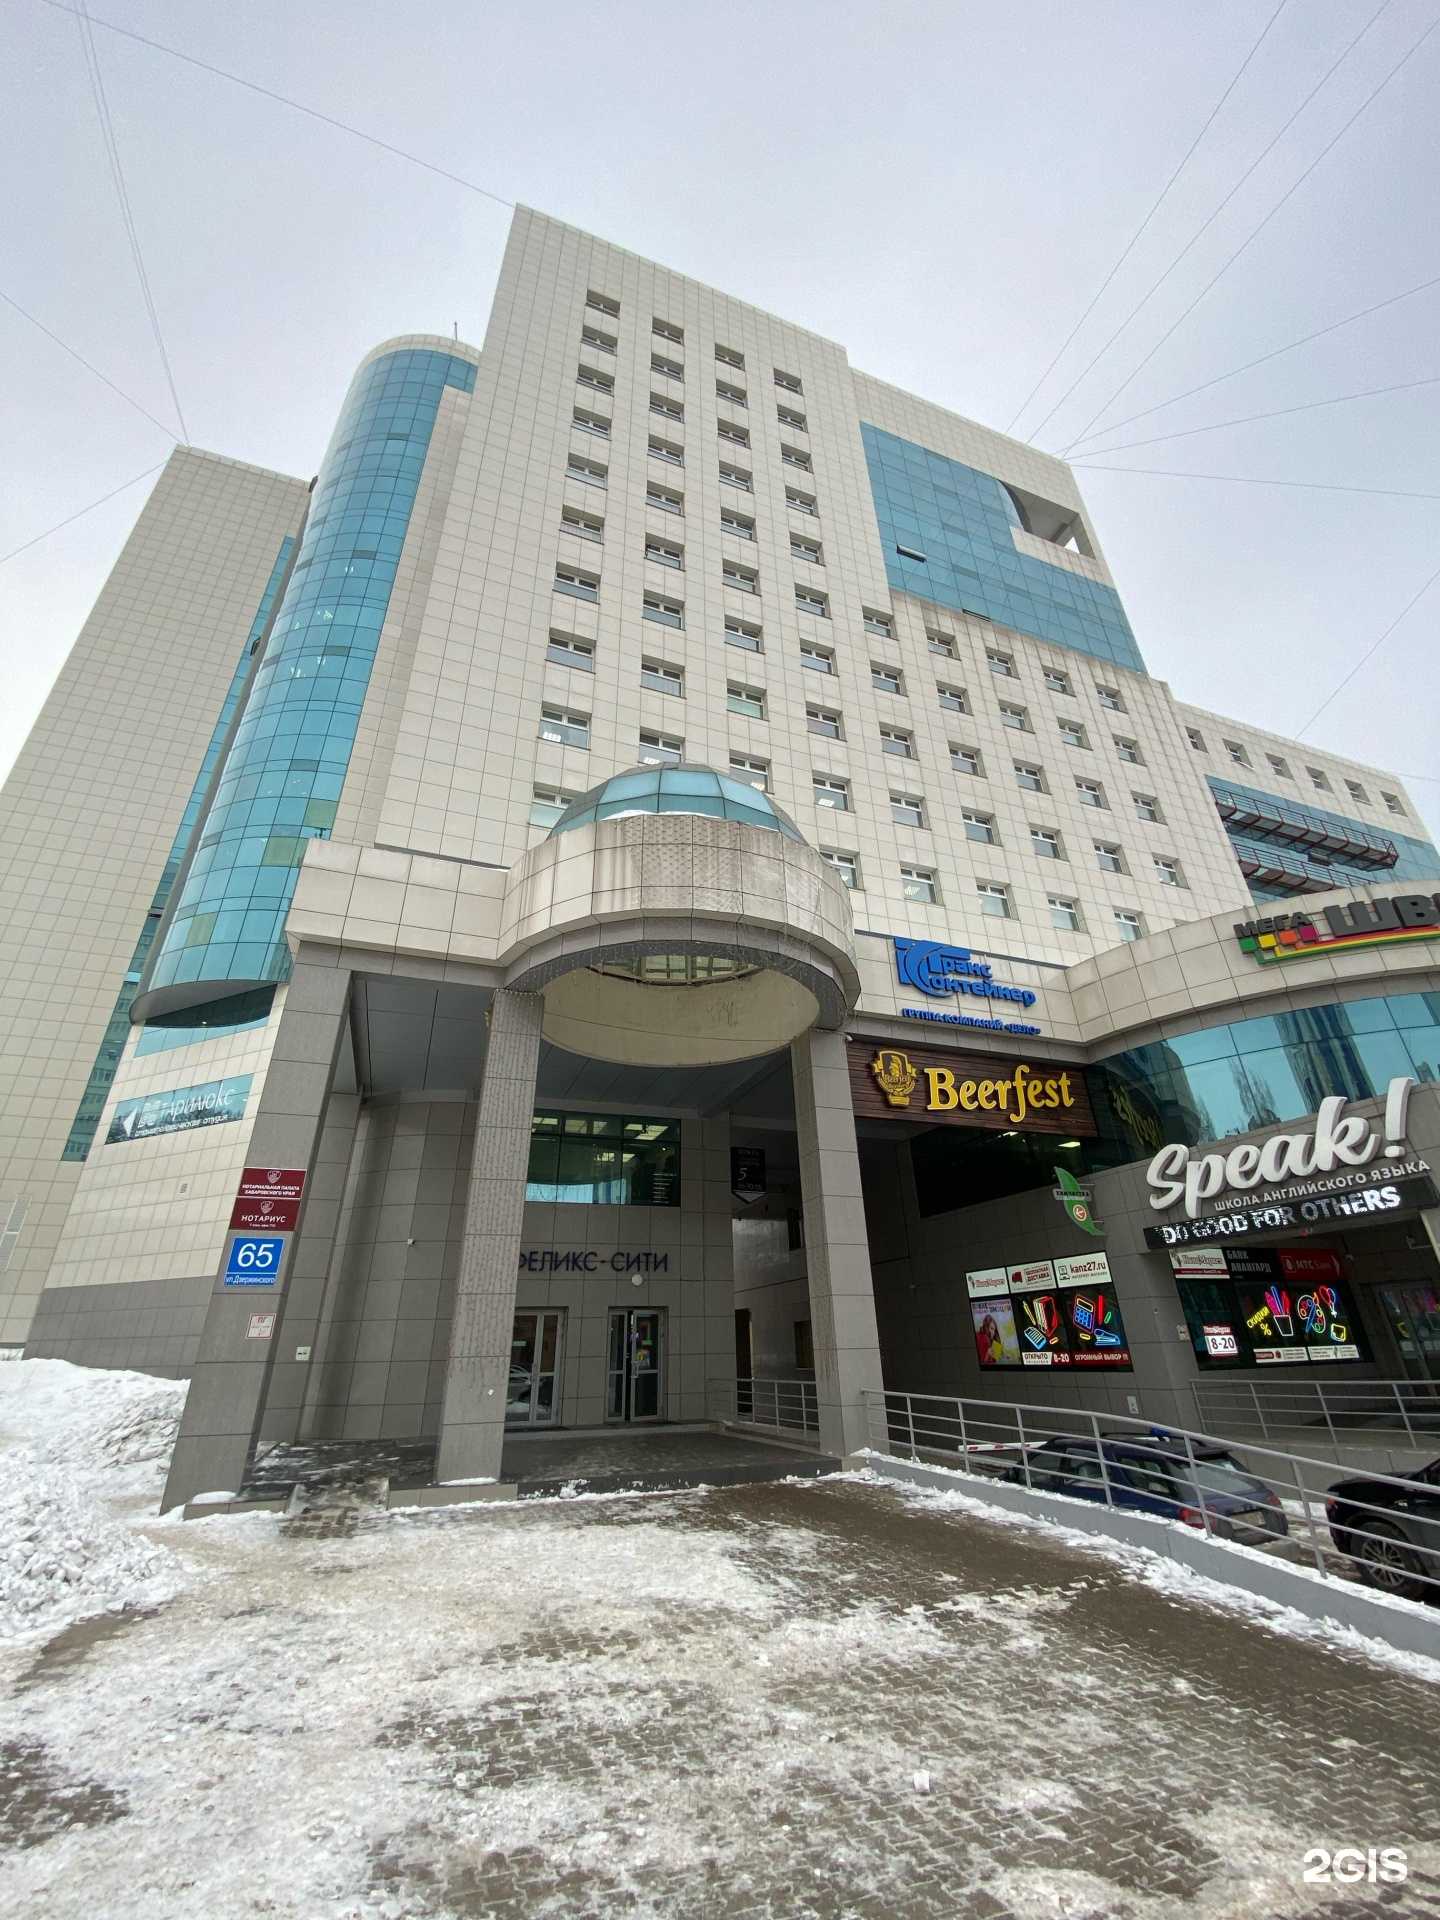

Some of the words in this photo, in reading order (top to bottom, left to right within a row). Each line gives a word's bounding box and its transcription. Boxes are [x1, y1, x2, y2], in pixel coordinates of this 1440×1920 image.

[1233, 911, 1313, 938] МЕГА
[1323, 891, 1440, 938] ШВ
[902, 1008, 942, 1021] ГРУППА
[942, 1013, 1002, 1030] КОМПАНИЙ
[924, 1064, 1075, 1123] Beerfest
[1146, 1077, 1414, 1218] Speak!
[1214, 1195, 1260, 1211] ШКОЛА
[1263, 1173, 1366, 1202] АНГЛИЙСКОГО
[1371, 1160, 1431, 1181] ЯЗЫКА
[241, 1214, 287, 1223] НОТАРИУС
[1251, 1206, 1297, 1229] FOR
[1301, 1186, 1401, 1221] OTHERS
[237, 1243, 275, 1268] 65
[1070, 1260, 1107, 1274] kanz27.ru
[1211, 1337, 1235, 1350] 8-20
